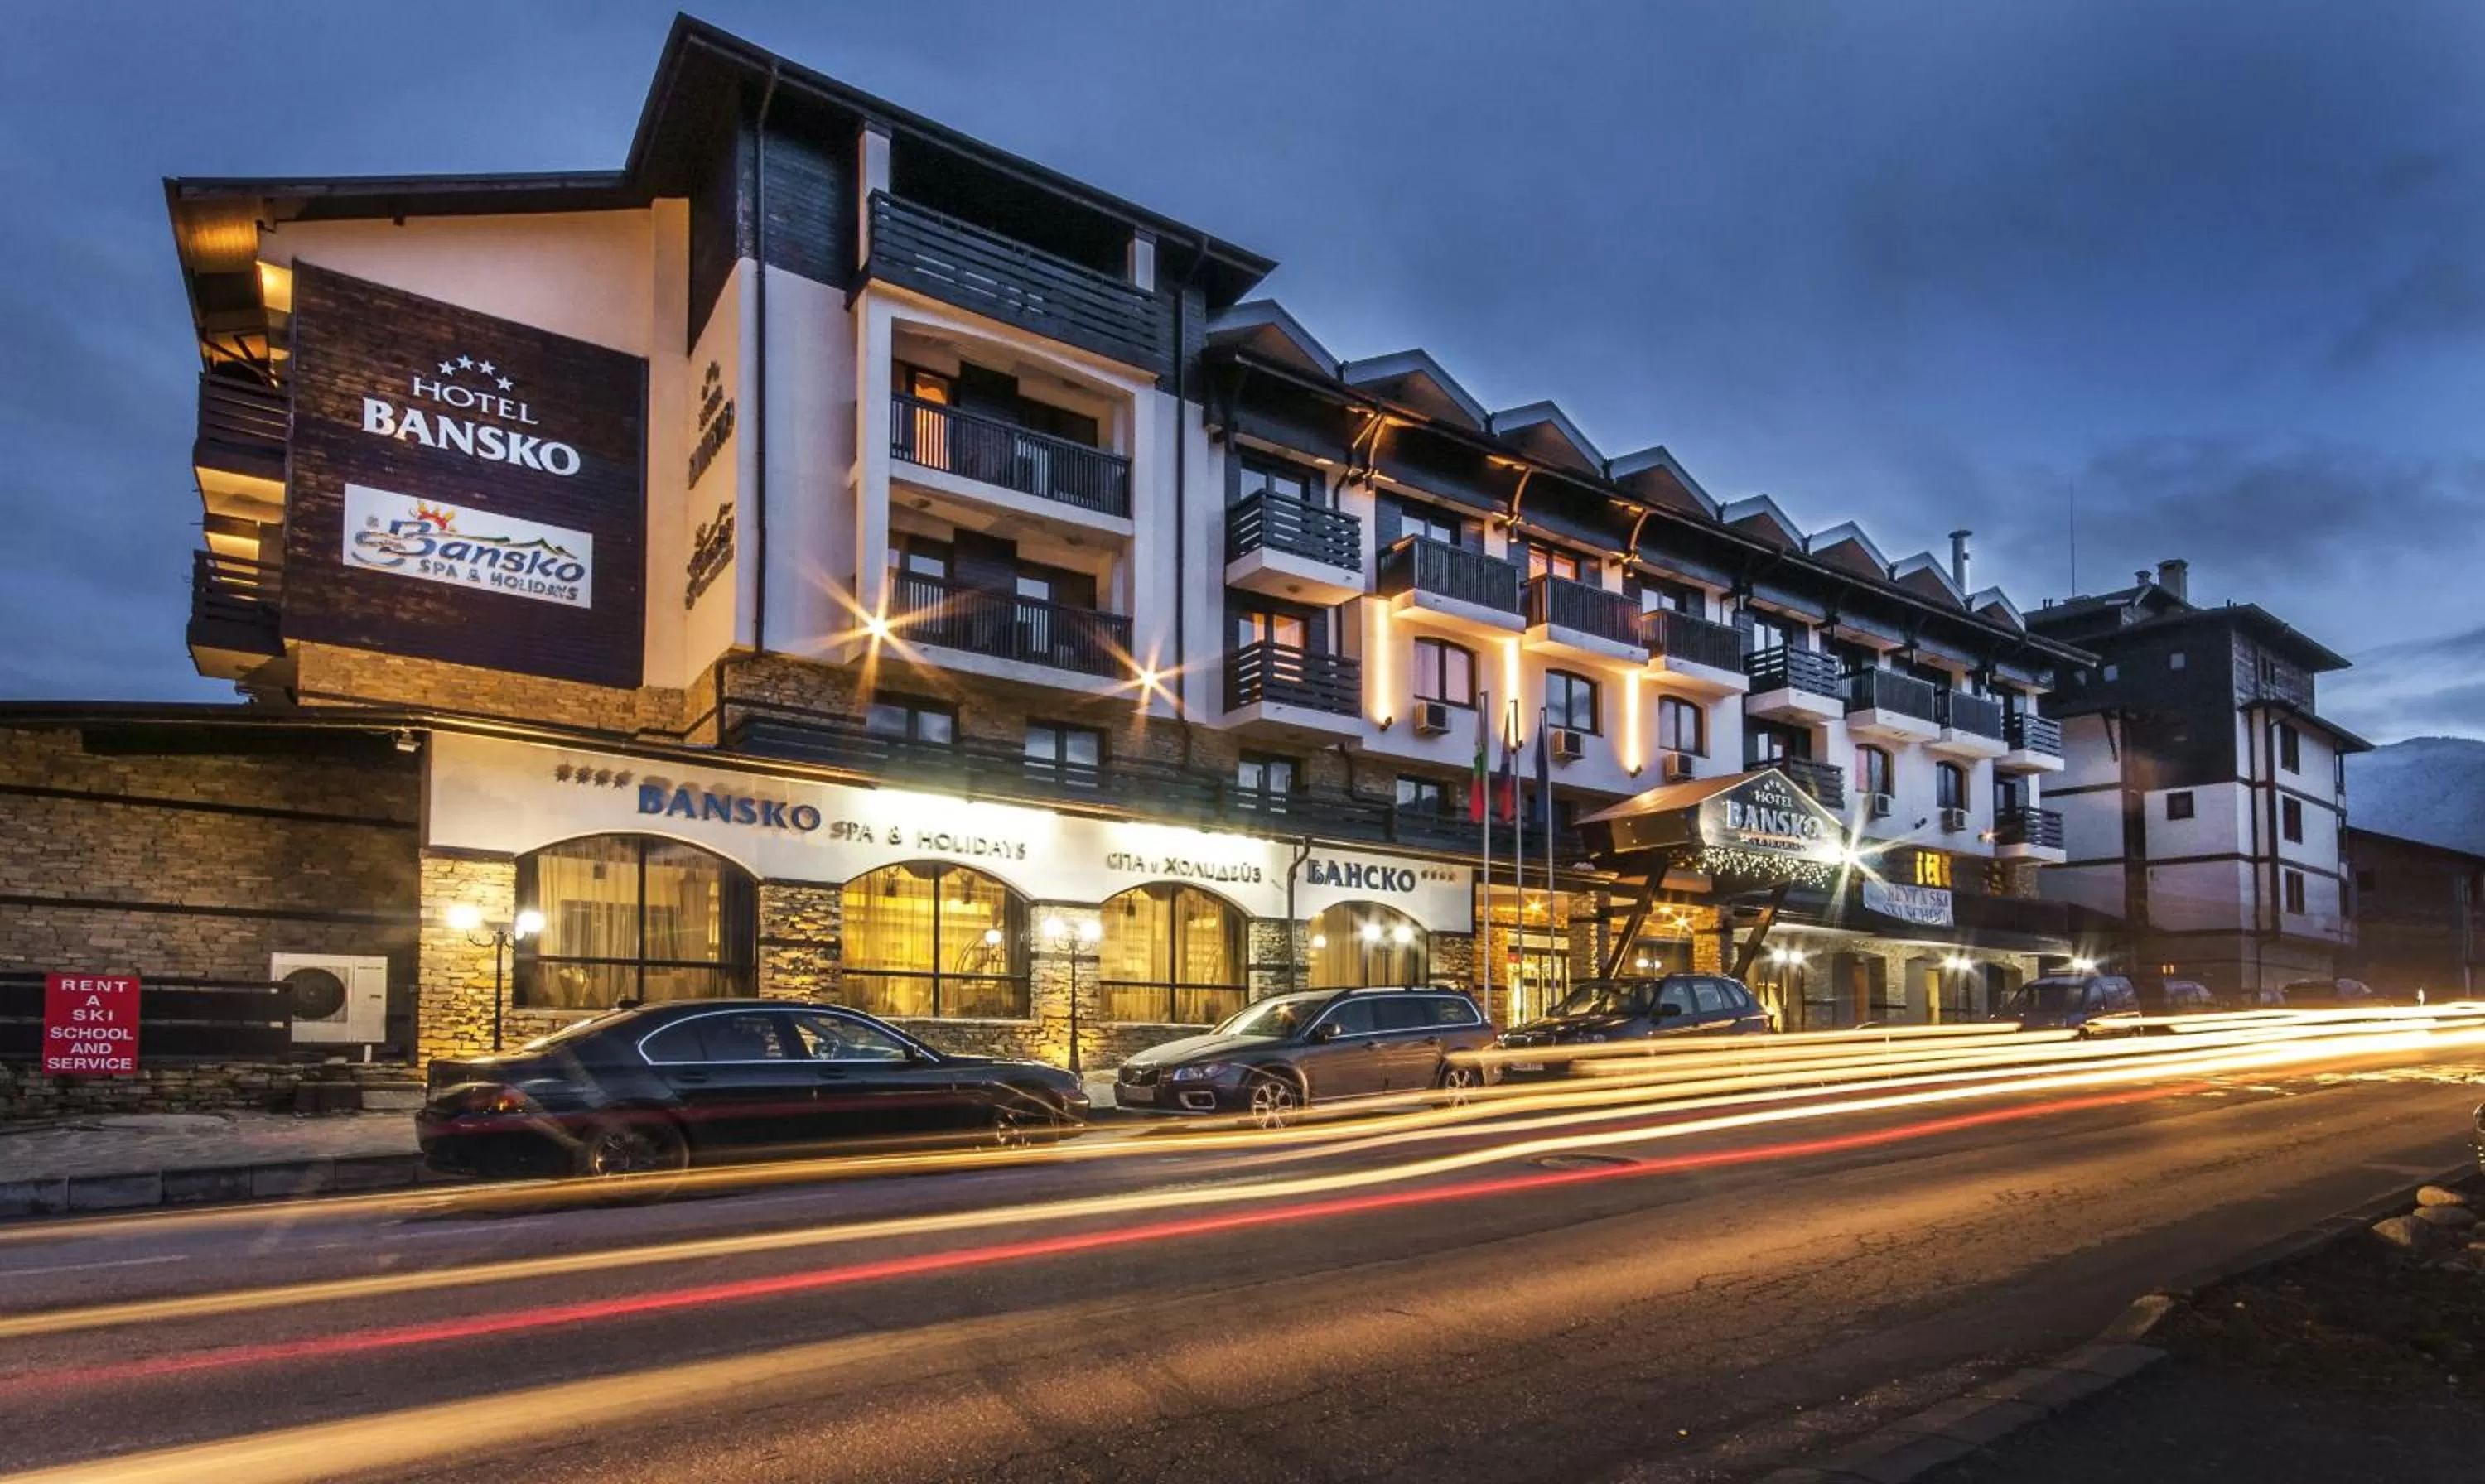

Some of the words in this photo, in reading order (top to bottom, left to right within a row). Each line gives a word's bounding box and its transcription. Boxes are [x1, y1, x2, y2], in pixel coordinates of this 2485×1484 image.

[413, 377, 539, 425] HOTEL
[362, 397, 581, 476] BANSKO
[378, 520, 585, 582] Bansko
[420, 559, 458, 578] SPA
[467, 569, 480, 583] &
[490, 572, 579, 601] HOLIDAYS
[1754, 789, 1793, 807] HOTEL
[637, 784, 821, 831] BANSKO
[829, 821, 874, 843] SPA
[888, 826, 902, 845] &
[917, 830, 1026, 860] HOLIDAYS
[1726, 800, 1825, 839] BANSKO
[1107, 852, 1145, 872] СПА
[1307, 859, 1416, 893] БАНСКО
[60, 979, 128, 992] RENT
[85, 995, 100, 1006] A
[72, 1009, 113, 1021] SKI
[50, 1027, 133, 1040] SCHOOL
[70, 1042, 112, 1054] AND
[47, 1058, 133, 1070] SERVICE
